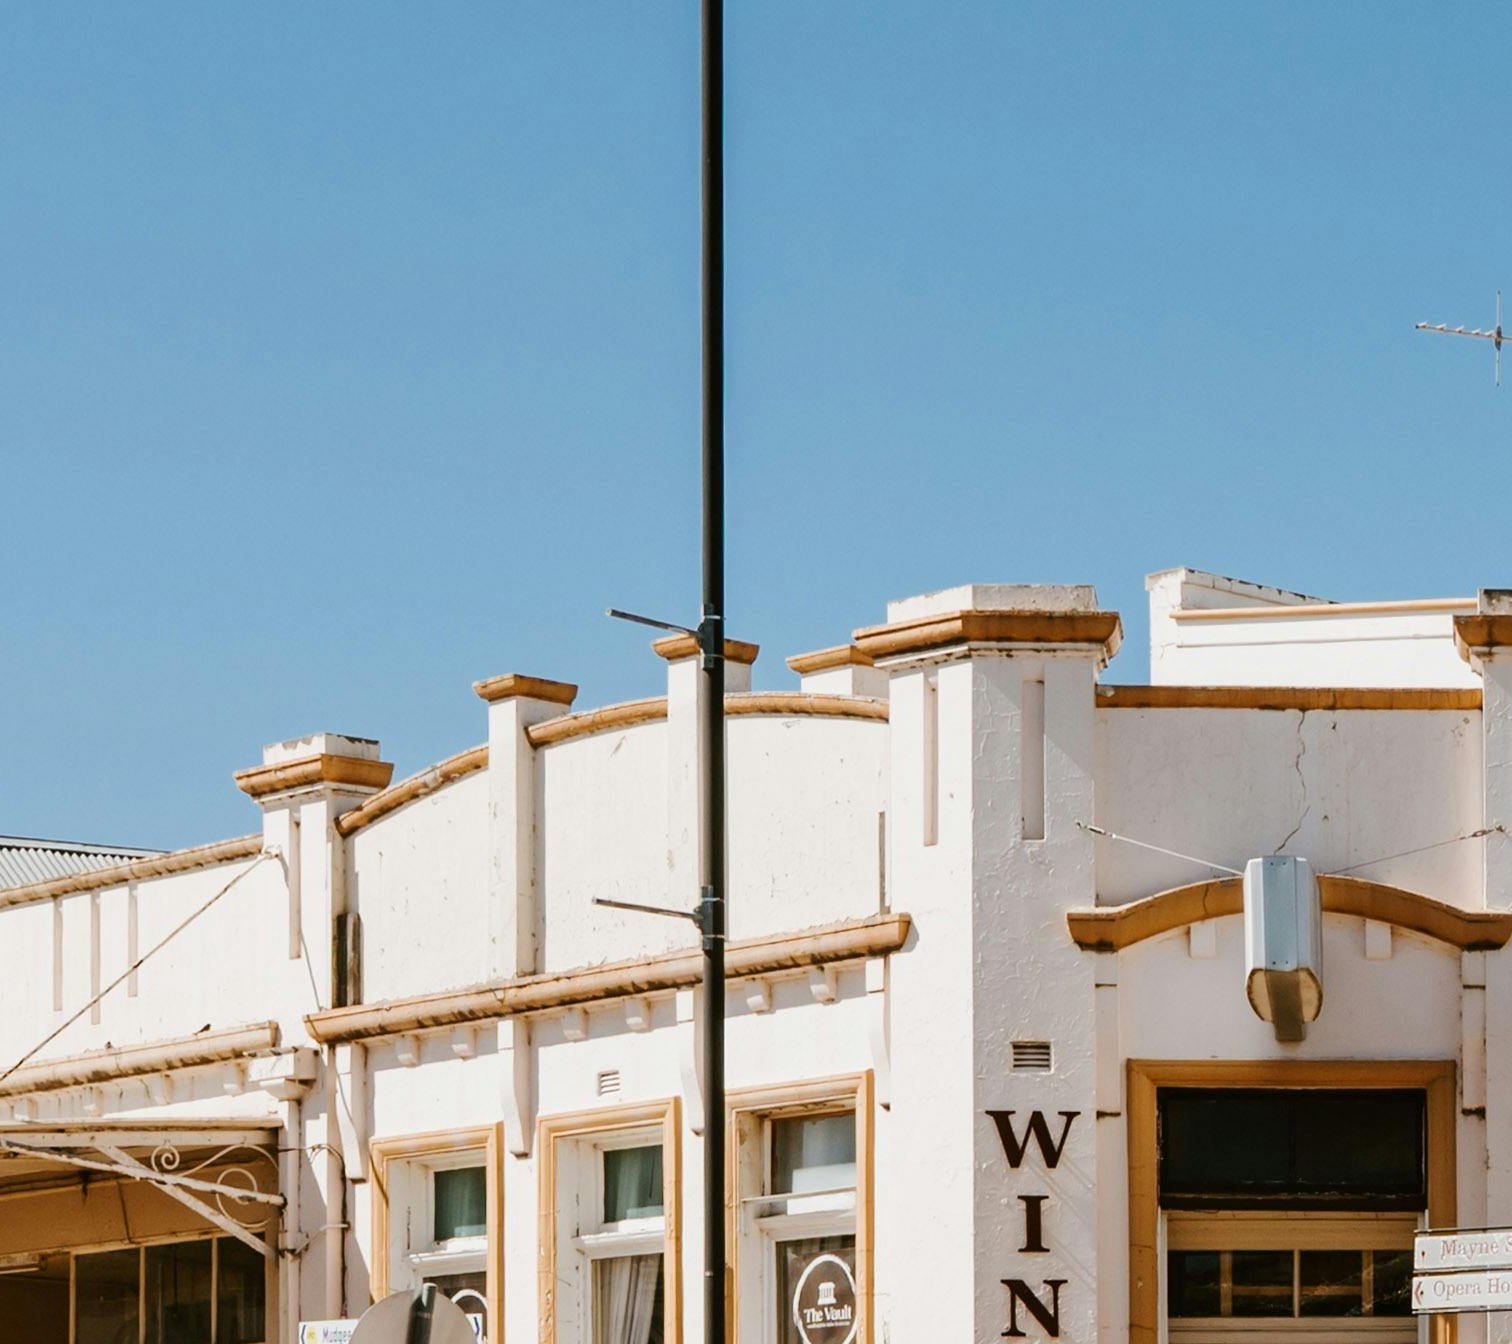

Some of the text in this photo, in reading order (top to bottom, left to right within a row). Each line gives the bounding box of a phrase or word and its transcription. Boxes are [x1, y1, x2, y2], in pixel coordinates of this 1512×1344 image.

[1440, 1239, 1499, 1260] Mayne
[1433, 1280, 1481, 1300] Opera
[803, 1304, 851, 1324] The Vault
